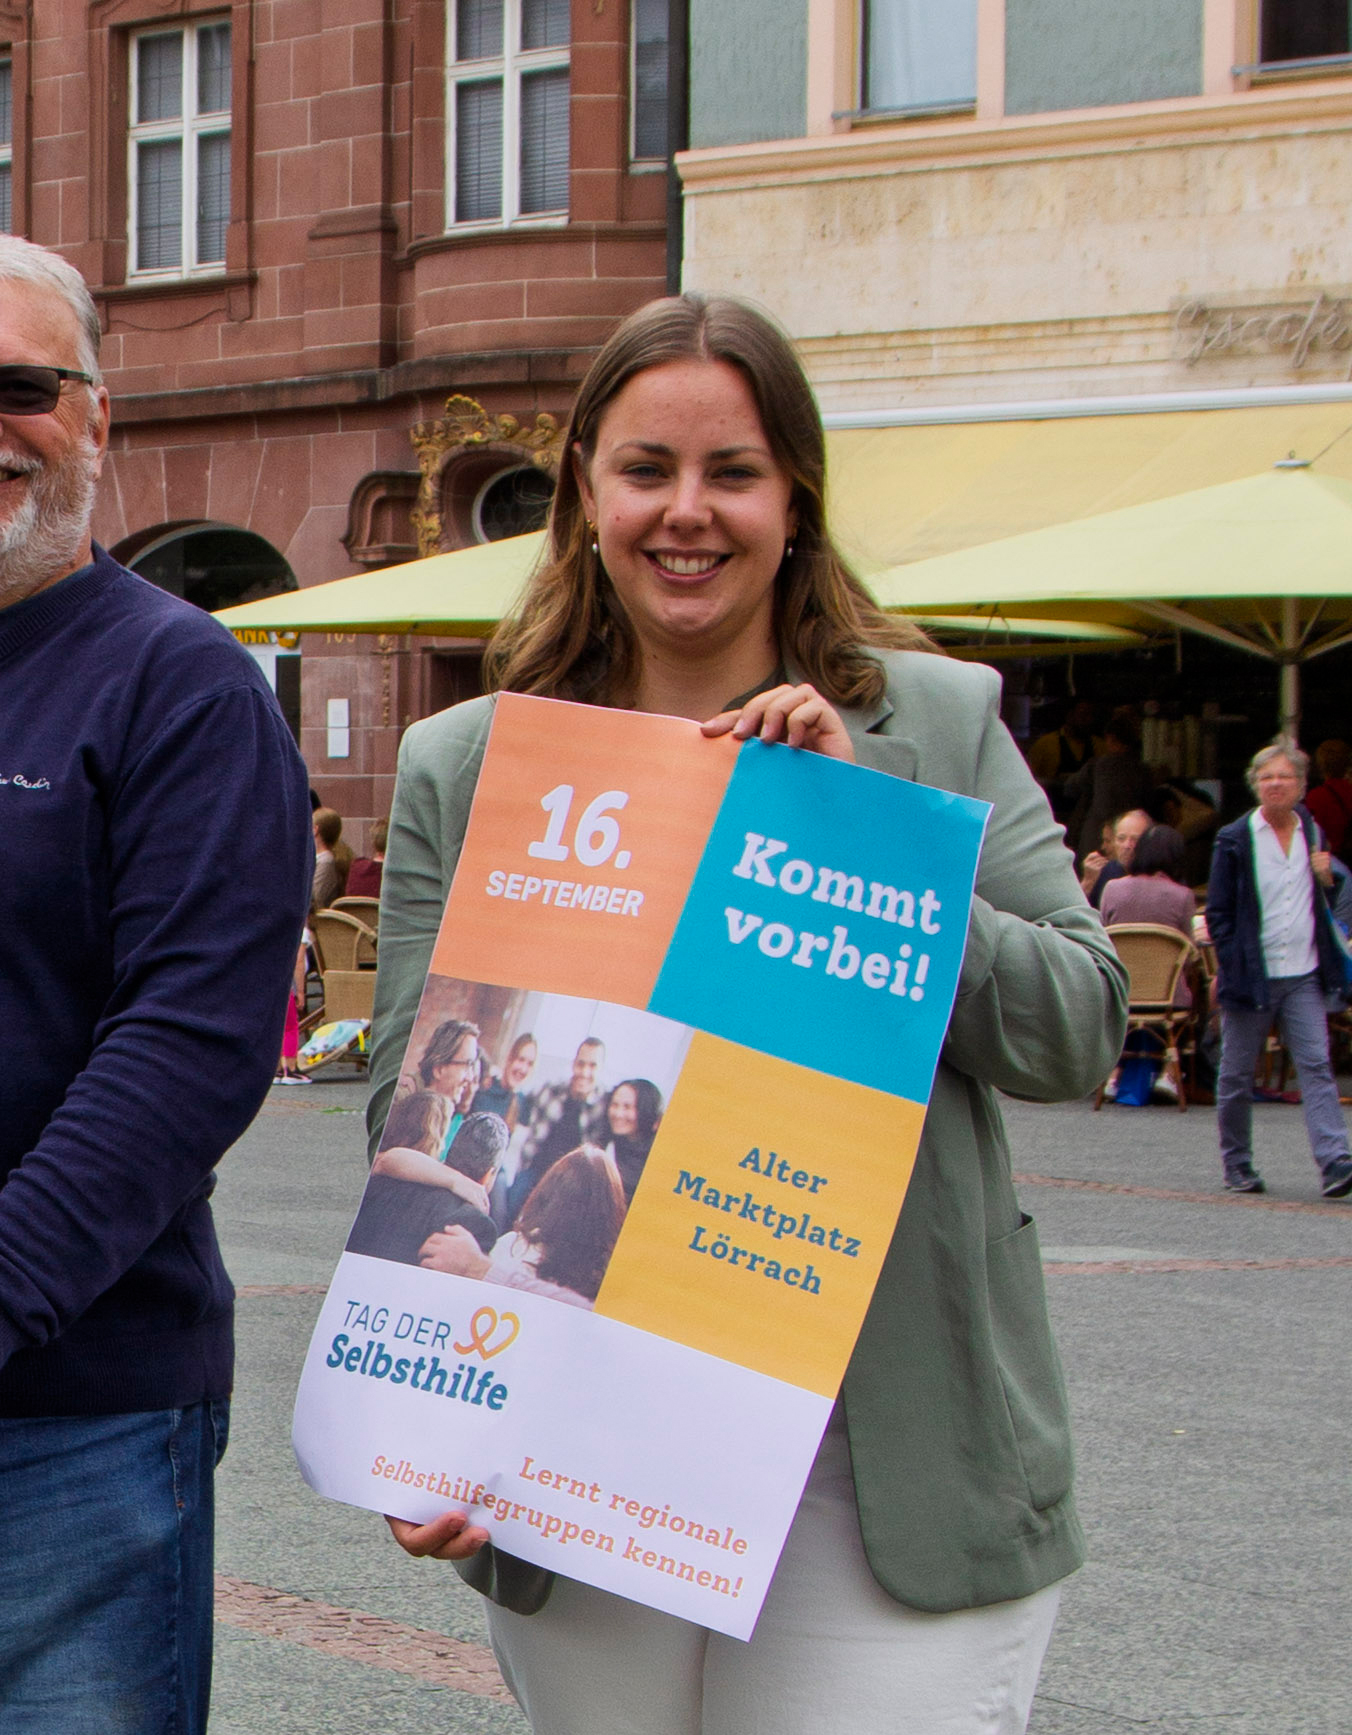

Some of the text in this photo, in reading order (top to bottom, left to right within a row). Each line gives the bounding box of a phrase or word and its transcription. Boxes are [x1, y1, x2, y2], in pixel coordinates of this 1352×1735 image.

[528, 784, 631, 869] 16.
[486, 870, 644, 917] SEPTEMBER
[732, 832, 941, 935] Kommt
[725, 907, 930, 1002] vorbei!
[738, 1147, 828, 1194] Alter
[673, 1170, 862, 1257] Marktplatz
[689, 1225, 821, 1295] Lörrach
[344, 1300, 451, 1350] TAG DER
[326, 1333, 508, 1410] Selbsthilfe
[371, 1454, 743, 1599] Selbsthilfegruppen kennen!
[519, 1456, 748, 1556] Lernt regionale
